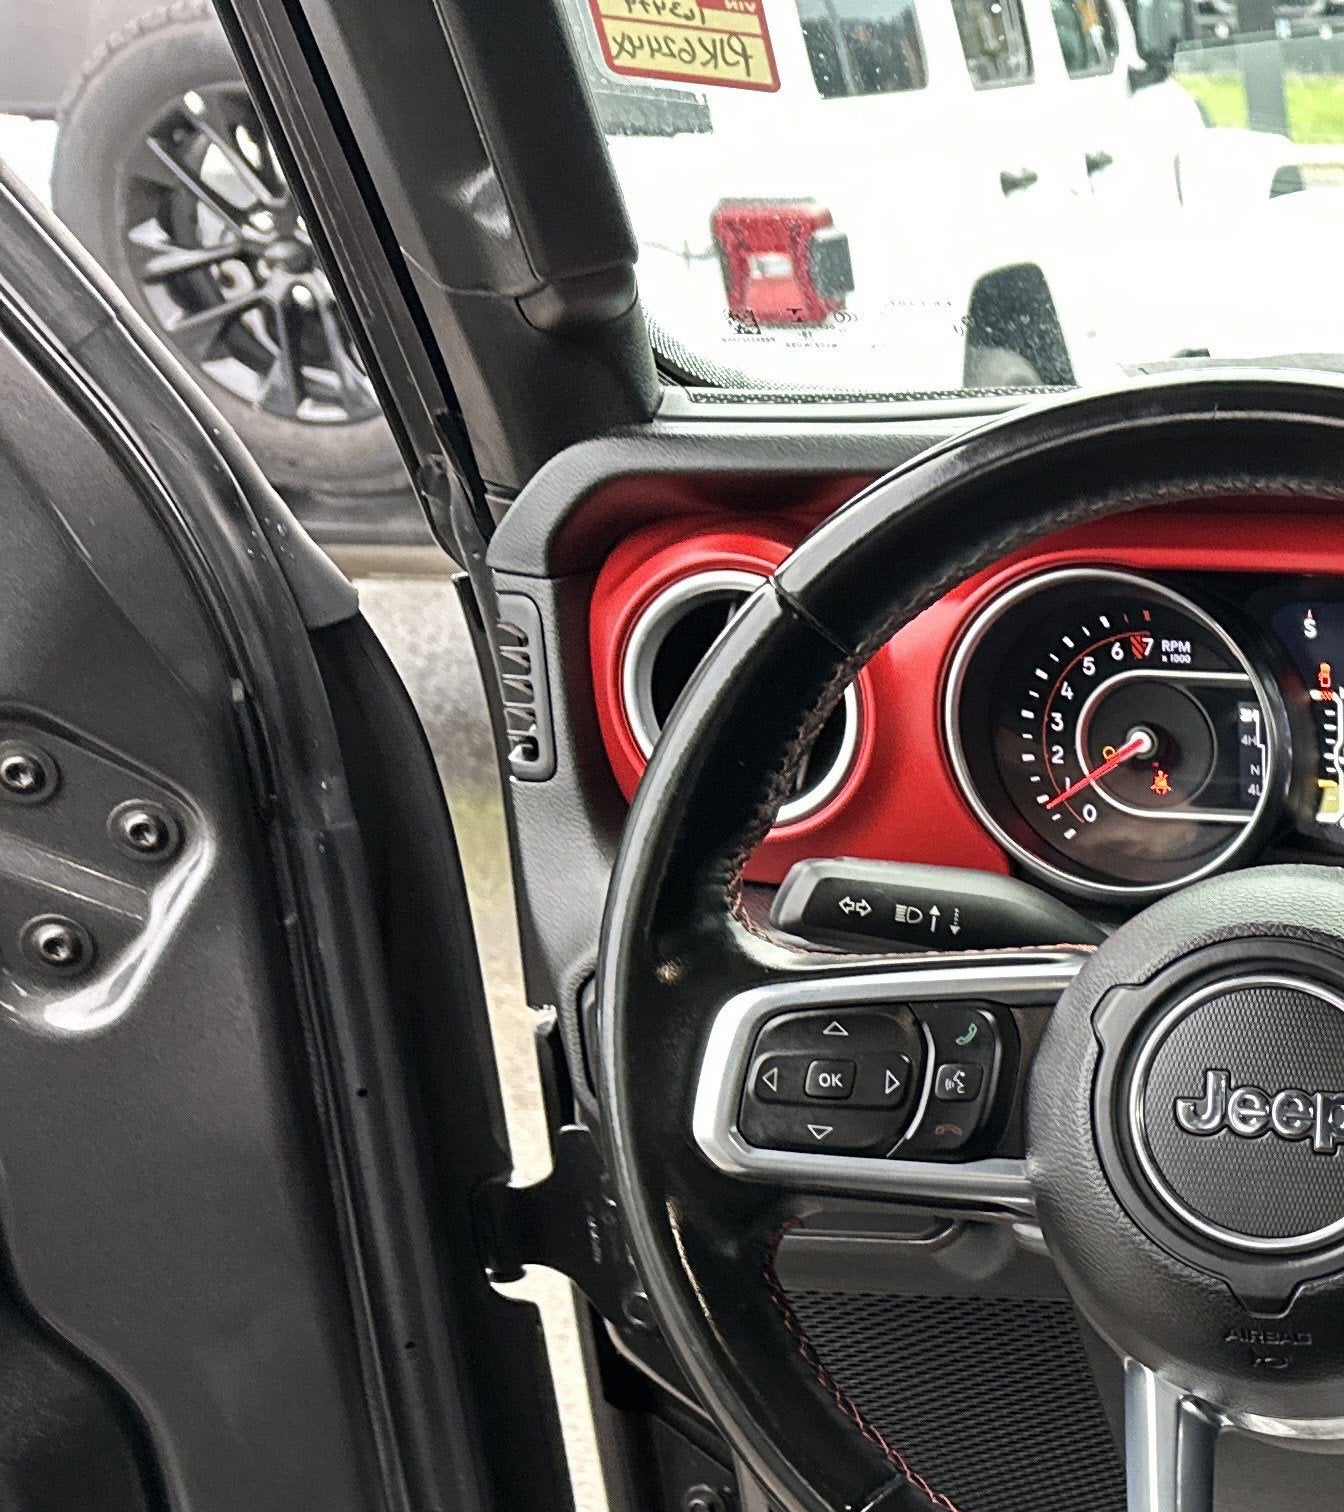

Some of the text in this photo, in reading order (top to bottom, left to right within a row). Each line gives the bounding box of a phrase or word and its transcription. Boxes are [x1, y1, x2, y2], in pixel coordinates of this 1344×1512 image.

[1111, 642, 1124, 660] 6
[1142, 637, 1154, 656] 7
[1161, 640, 1191, 654] RPM
[1082, 657, 1096, 675] 5
[1060, 682, 1074, 700] 4
[1051, 712, 1064, 731] 3
[1051, 746, 1064, 764] 2
[1251, 765, 1260, 775] N
[1083, 804, 1096, 822] 0
[818, 1072, 843, 1088] OK
[1225, 1327, 1314, 1346] AIRBAG
